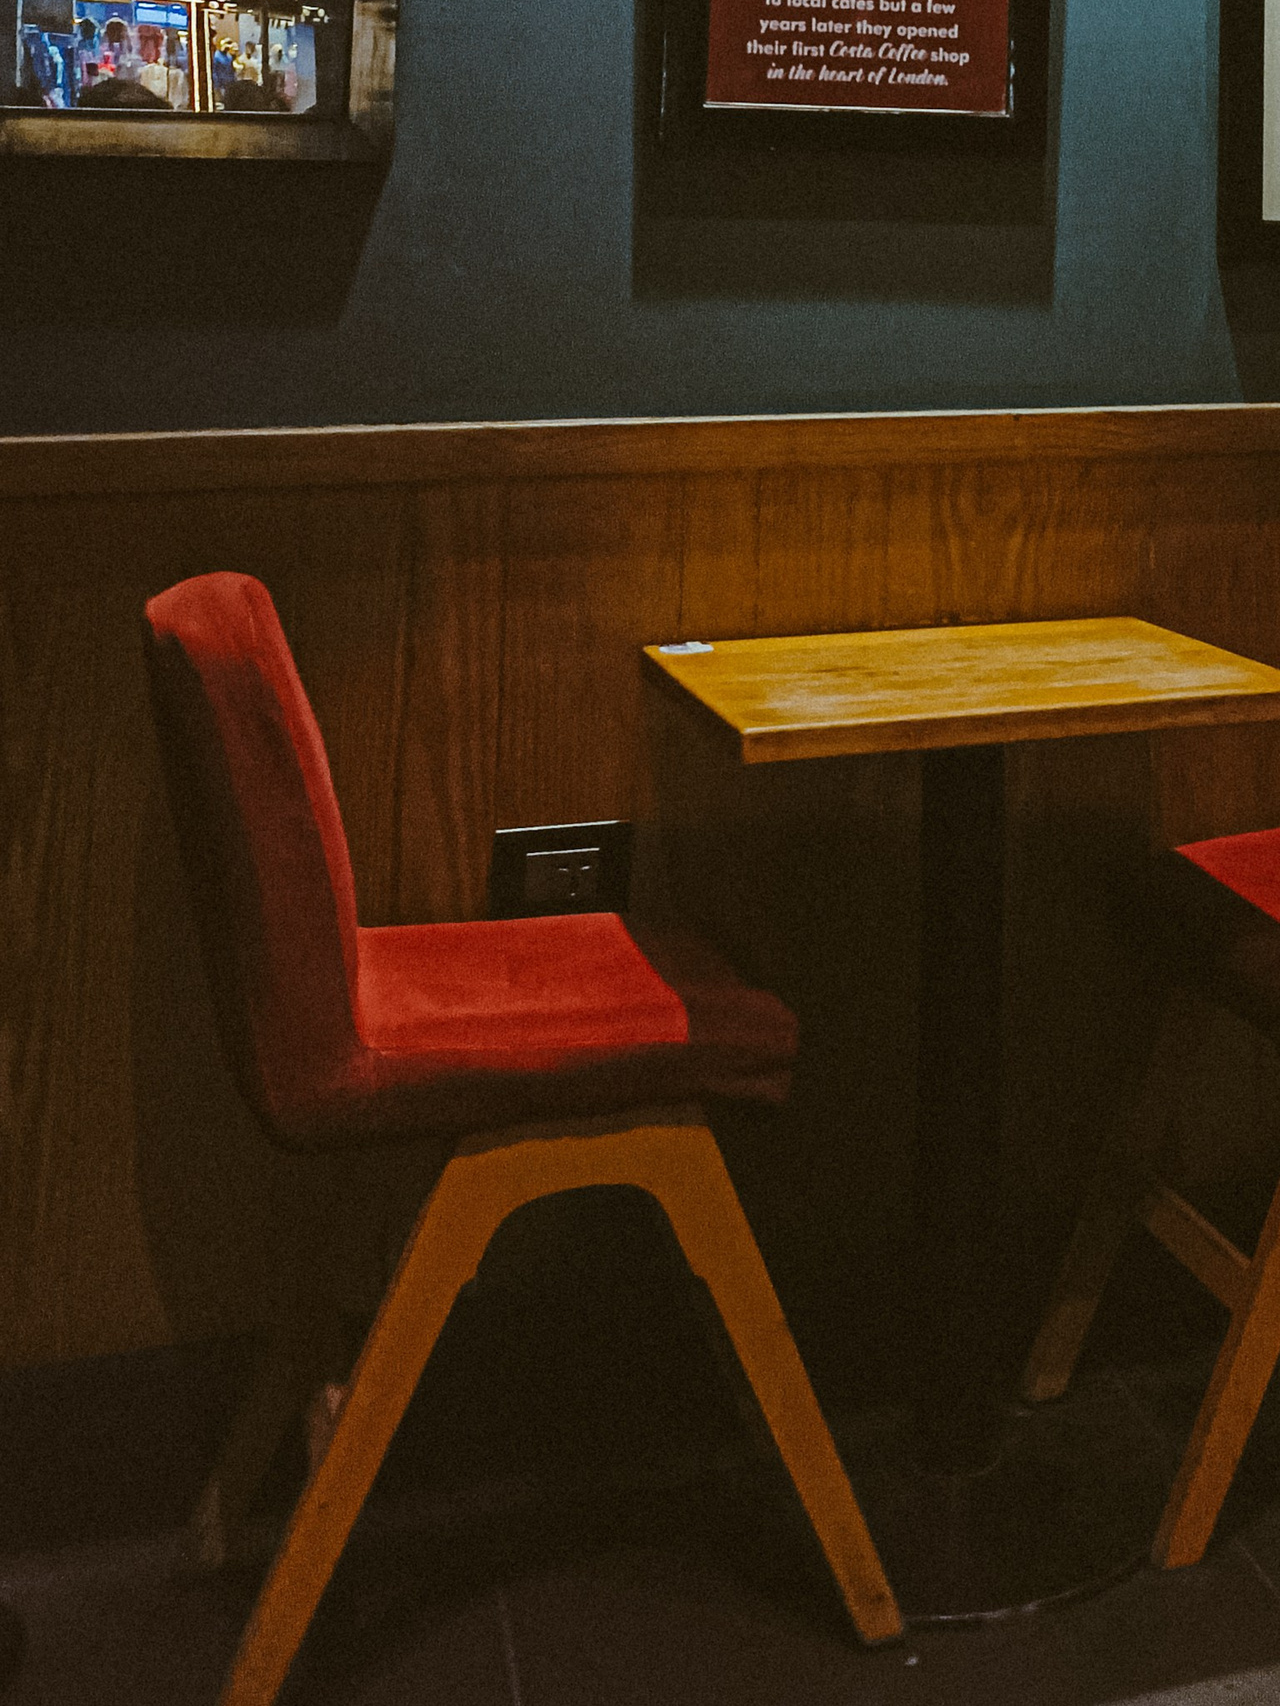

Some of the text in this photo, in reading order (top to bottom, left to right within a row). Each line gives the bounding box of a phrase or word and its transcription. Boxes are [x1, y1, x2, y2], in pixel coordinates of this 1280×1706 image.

[910, 1, 922, 13] a
[759, 16, 959, 40] years later they opened
[746, 38, 970, 67] their first Costa Coffee shop
[766, 61, 949, 87] in the heart of London.
